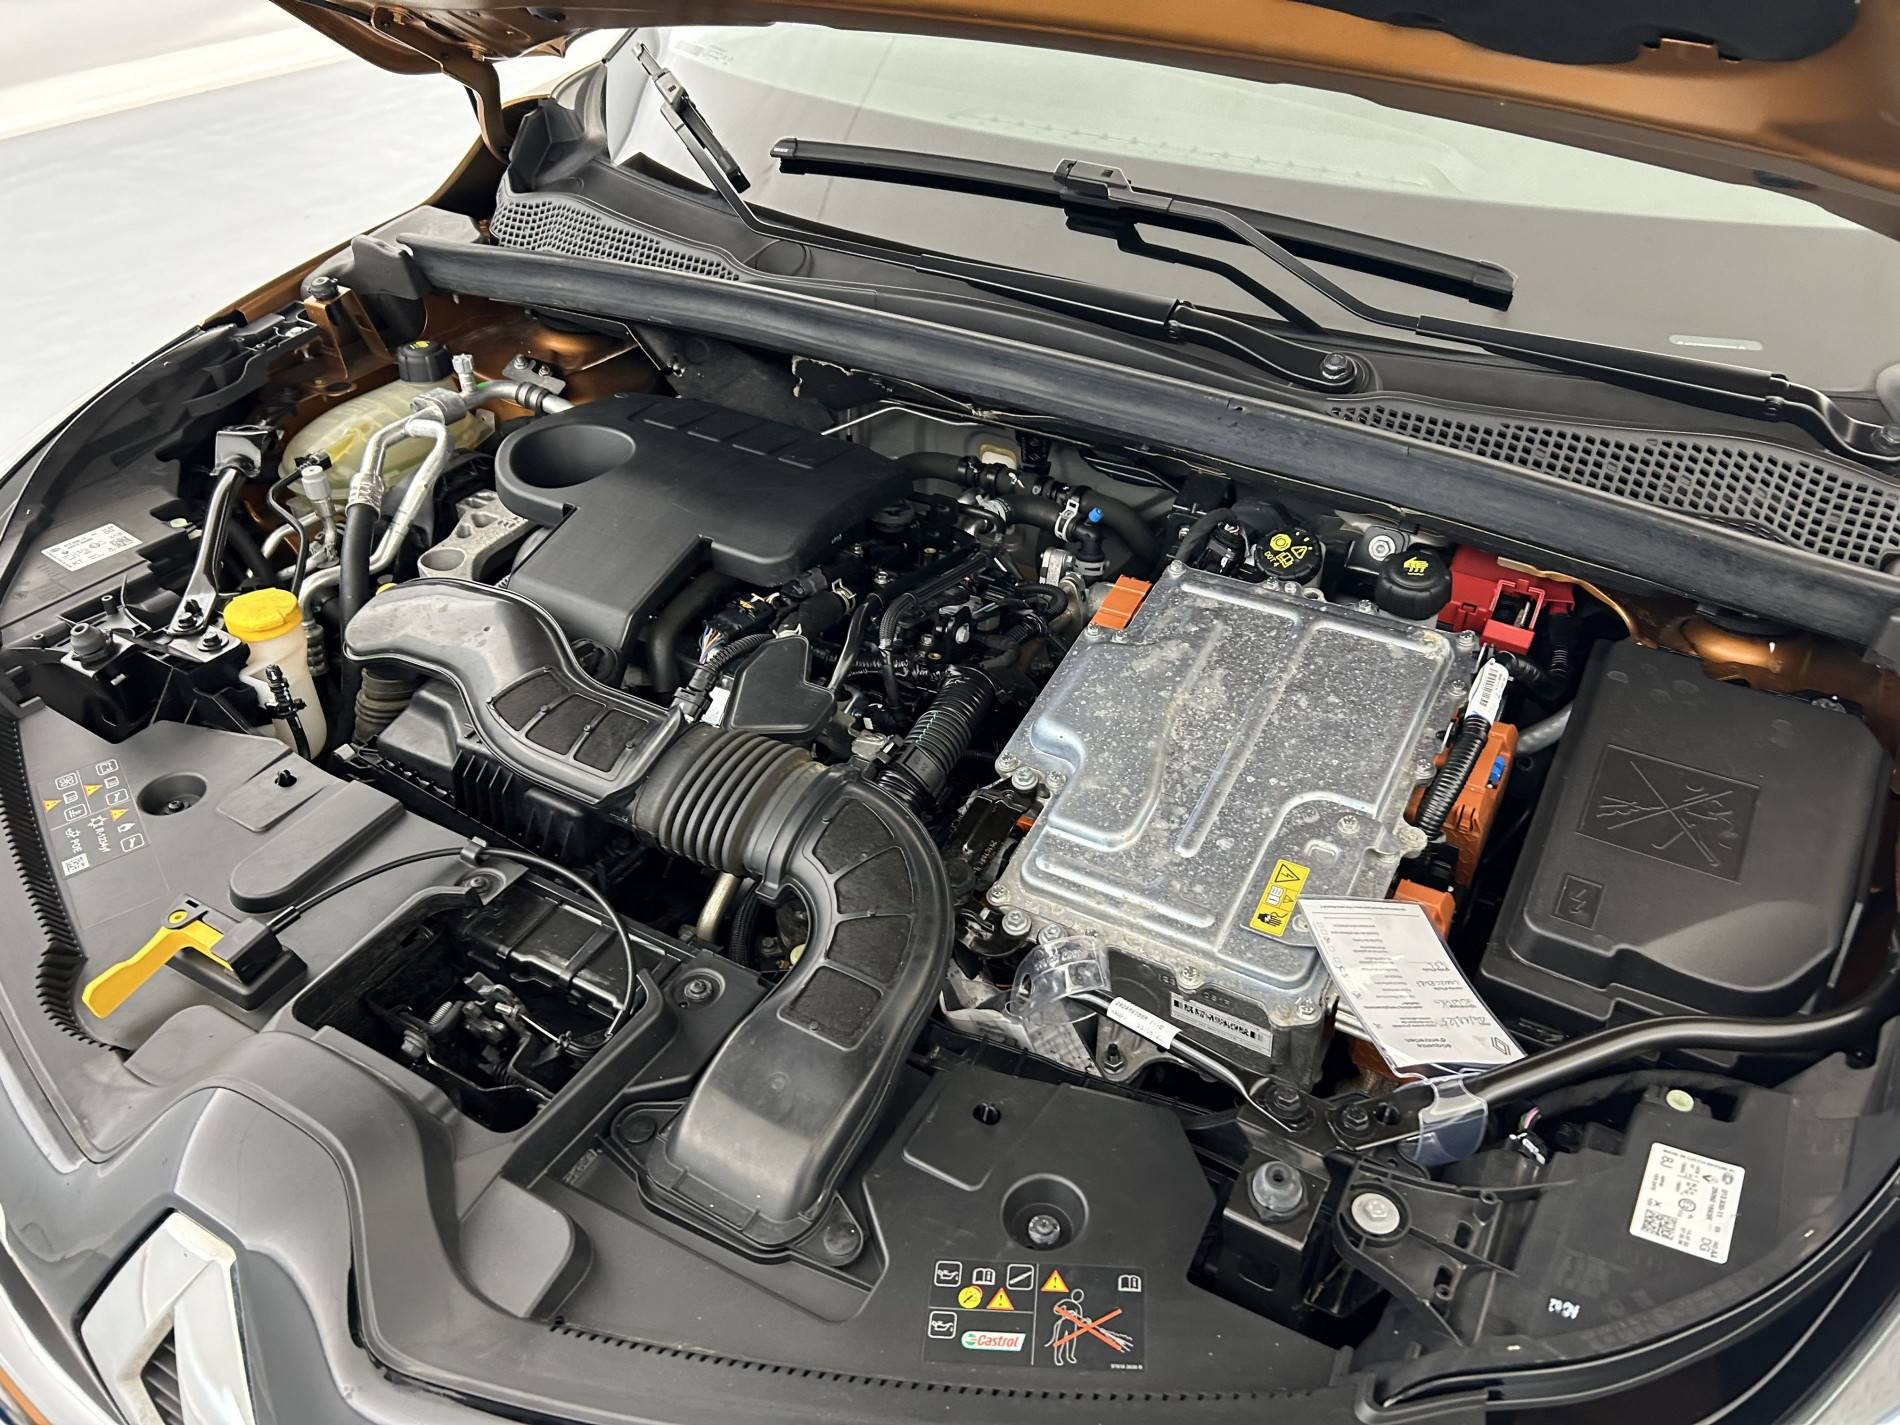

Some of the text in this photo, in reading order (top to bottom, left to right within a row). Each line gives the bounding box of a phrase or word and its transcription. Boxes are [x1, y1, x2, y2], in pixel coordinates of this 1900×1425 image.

[1264, 551, 1276, 562] DOT
[70, 838, 82, 853] POE
[95, 827, 111, 852] R-1234yf
[977, 1334, 1019, 1347] Castrol
